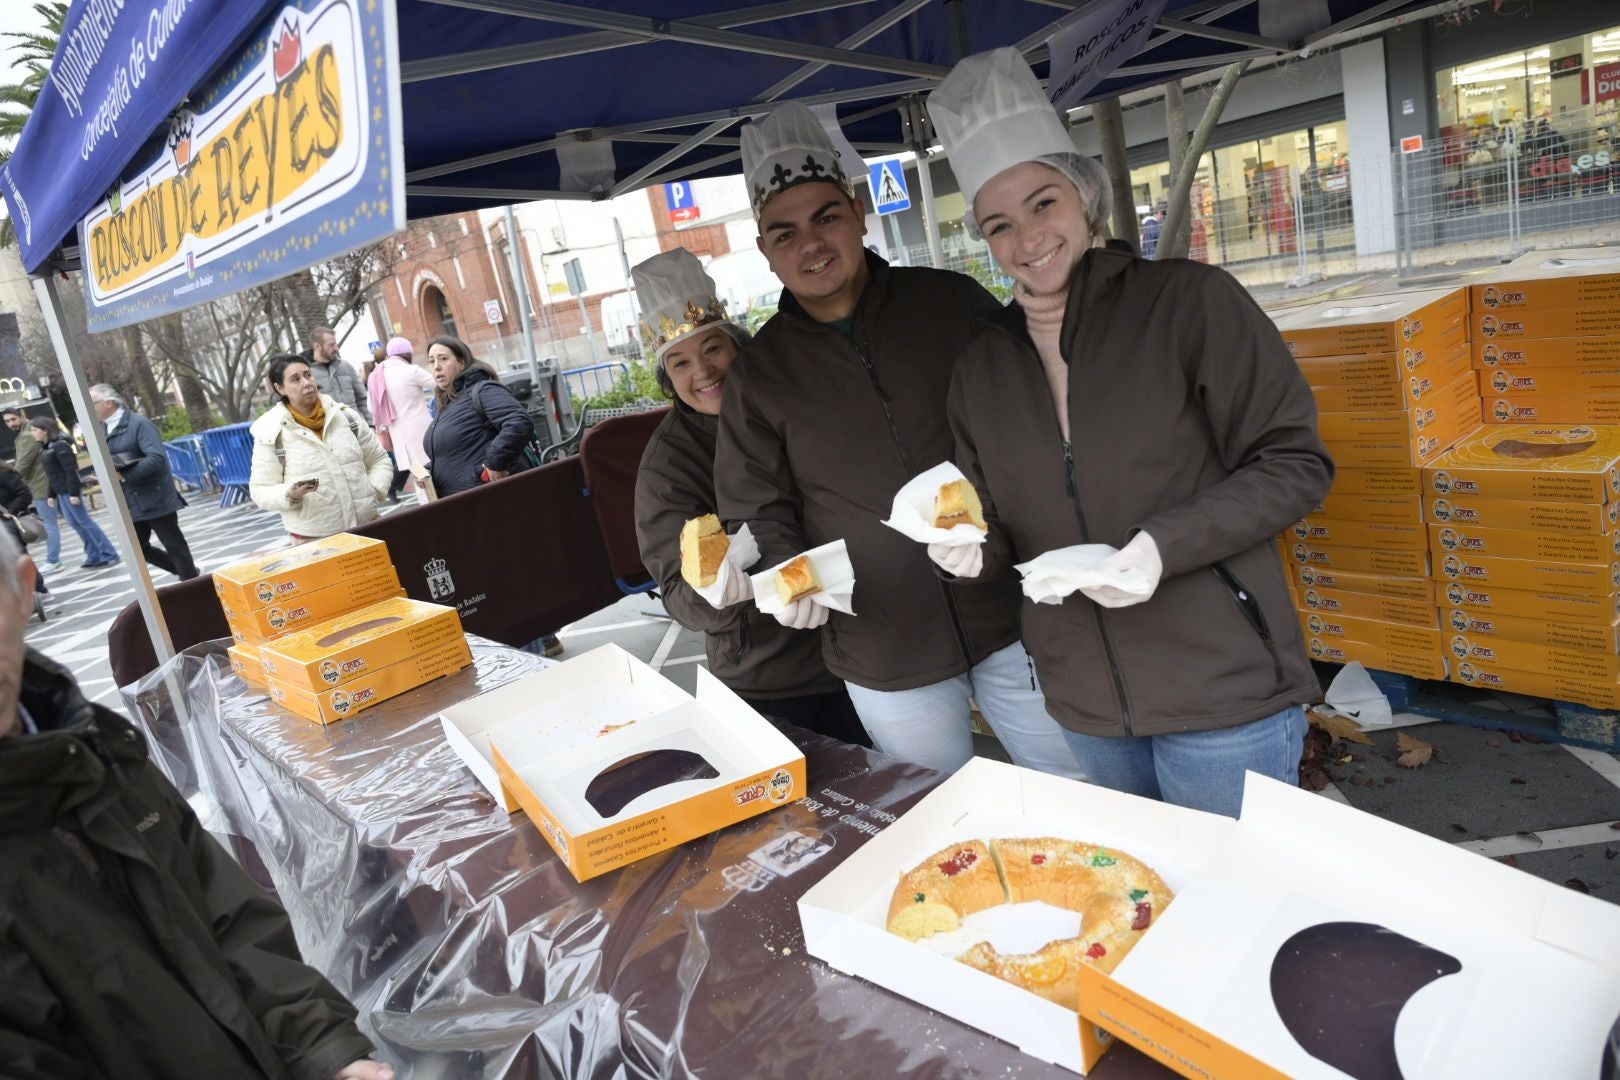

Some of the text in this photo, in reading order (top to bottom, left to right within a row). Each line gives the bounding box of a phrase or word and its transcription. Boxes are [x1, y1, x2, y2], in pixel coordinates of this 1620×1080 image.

[130, 38, 146, 88] de
[147, 0, 194, 61] Cultur
[51, 0, 125, 118] Ayuntamient
[93, 176, 168, 284] ROSCÓN
[172, 151, 207, 252] DE
[212, 42, 341, 229] REYES
[671, 182, 685, 208] P
[736, 785, 765, 805] CRUCE
[796, 797, 824, 812] Bad
[821, 788, 855, 806] Cultura
[821, 807, 839, 818] de
[855, 802, 870, 812] de
[625, 829, 660, 845] Alimentos
[593, 839, 661, 868] Productos Caseros
